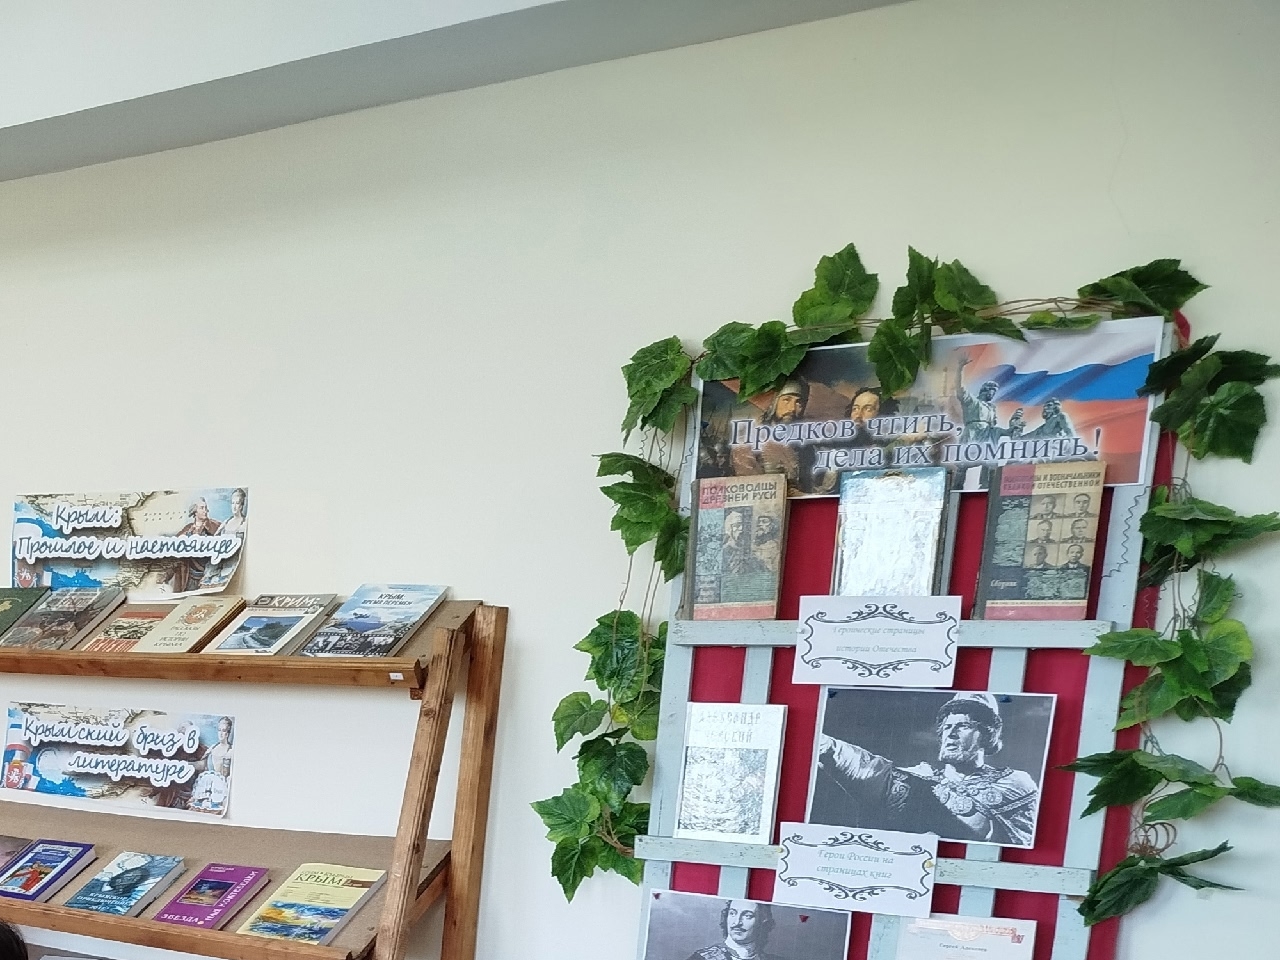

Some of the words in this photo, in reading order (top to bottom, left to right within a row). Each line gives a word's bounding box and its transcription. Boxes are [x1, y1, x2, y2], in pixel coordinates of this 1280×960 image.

[731, 418, 855, 450] Предков
[867, 413, 963, 439] чтить,
[814, 447, 885, 470] дела
[893, 446, 931, 466] их
[943, 427, 1101, 464] помнить!
[701, 493, 749, 505] ДРЕВНЕЙ
[753, 491, 777, 501] РУСИ
[702, 482, 777, 496] ПОЛКОВОДЦЫ
[55, 505, 120, 531] Крым:
[18, 537, 102, 561] Прошлое
[105, 541, 124, 554] и
[128, 537, 239, 561] настоящее
[23, 717, 127, 743] Крымский
[136, 726, 182, 752] бриз
[186, 730, 197, 749] в
[68, 752, 190, 783] литературе
[818, 849, 845, 861] Герои
[847, 851, 880, 863] России
[295, 874, 343, 885] КРЫМ
[816, 865, 868, 878] страницах
[869, 870, 892, 879] книг
[161, 913, 199, 923] ЗВЕЗДА
